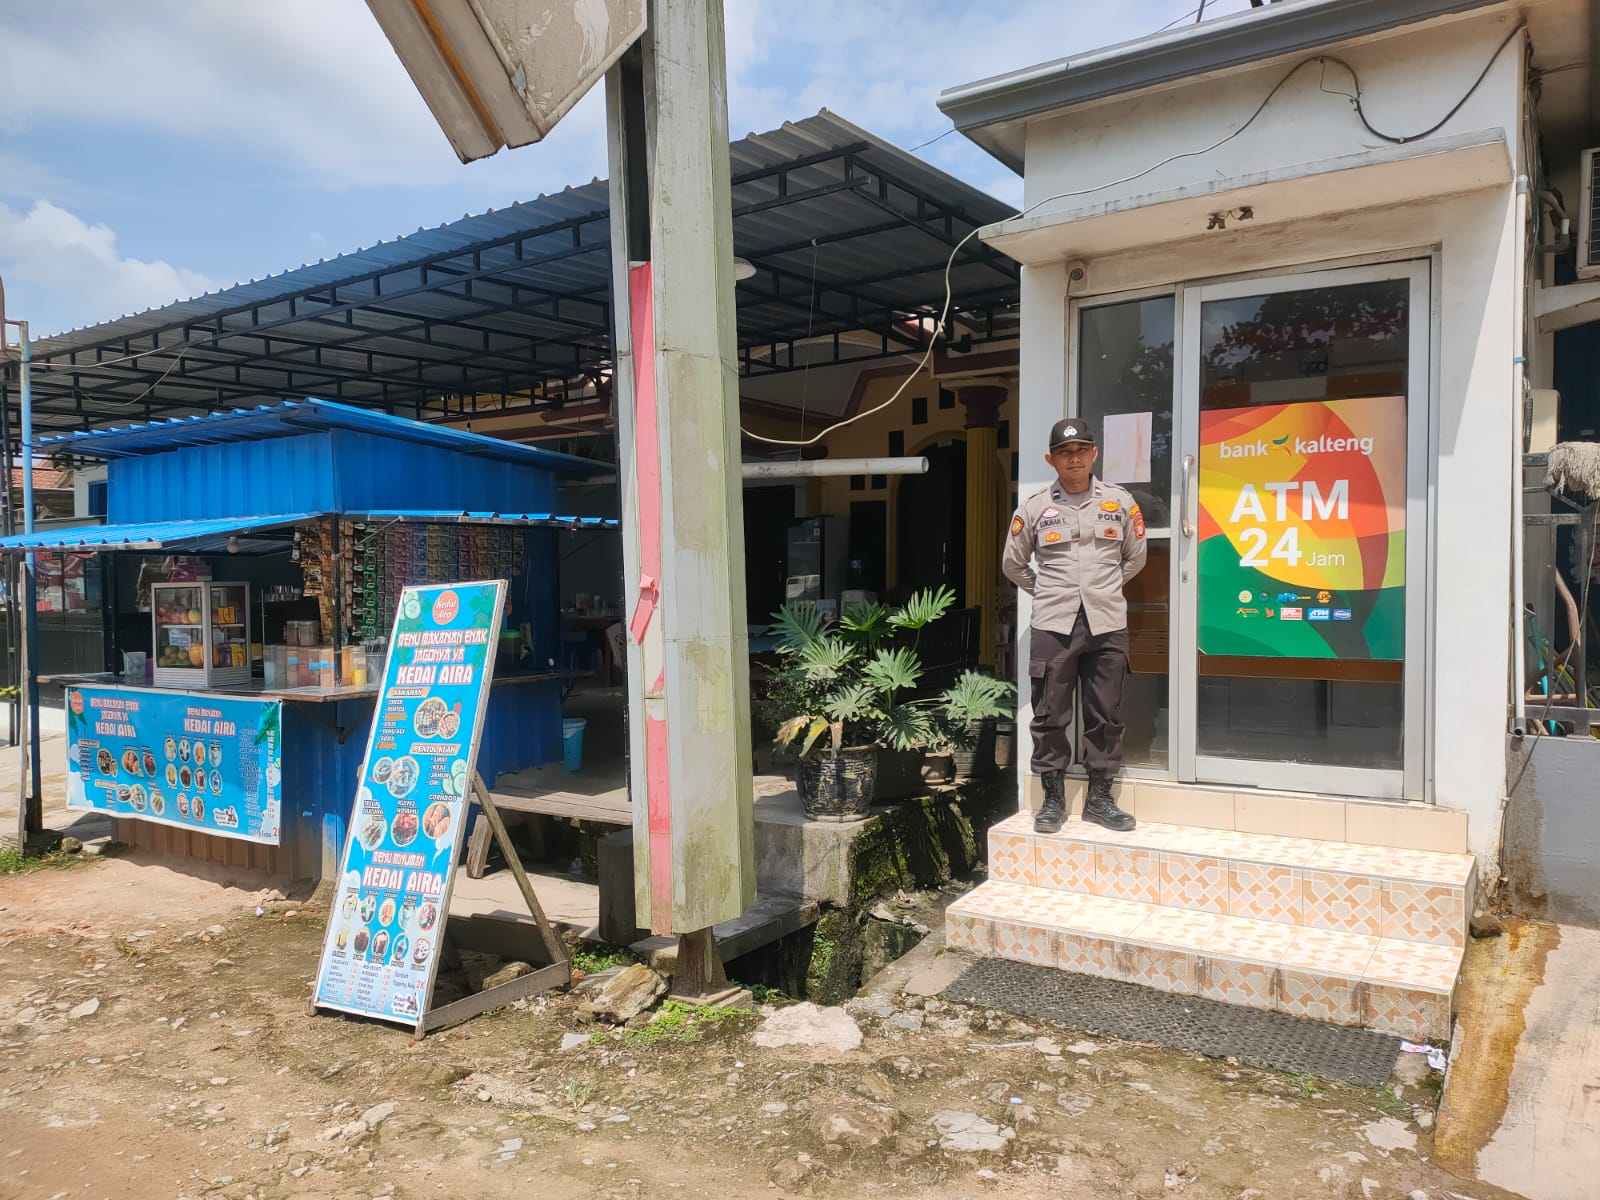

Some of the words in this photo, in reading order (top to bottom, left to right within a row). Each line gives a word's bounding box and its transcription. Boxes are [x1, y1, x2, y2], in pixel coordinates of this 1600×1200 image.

[1220, 440, 1268, 458] bank
[1296, 435, 1373, 455] kalteng
[1230, 479, 1349, 522] ATM
[1098, 514, 1122, 523] POLRI
[1239, 527, 1302, 567] 24
[1306, 552, 1345, 567] Jam
[398, 632, 422, 648] MENU
[422, 630, 464, 646] MAKANAN
[464, 628, 488, 644] ENAK
[396, 665, 437, 685] KEDAI
[438, 664, 473, 684] AIRA
[184, 718, 210, 734] KEDAI
[214, 721, 236, 736] AIRA
[362, 866, 404, 890] KEDAI
[406, 871, 442, 895] AIRA
